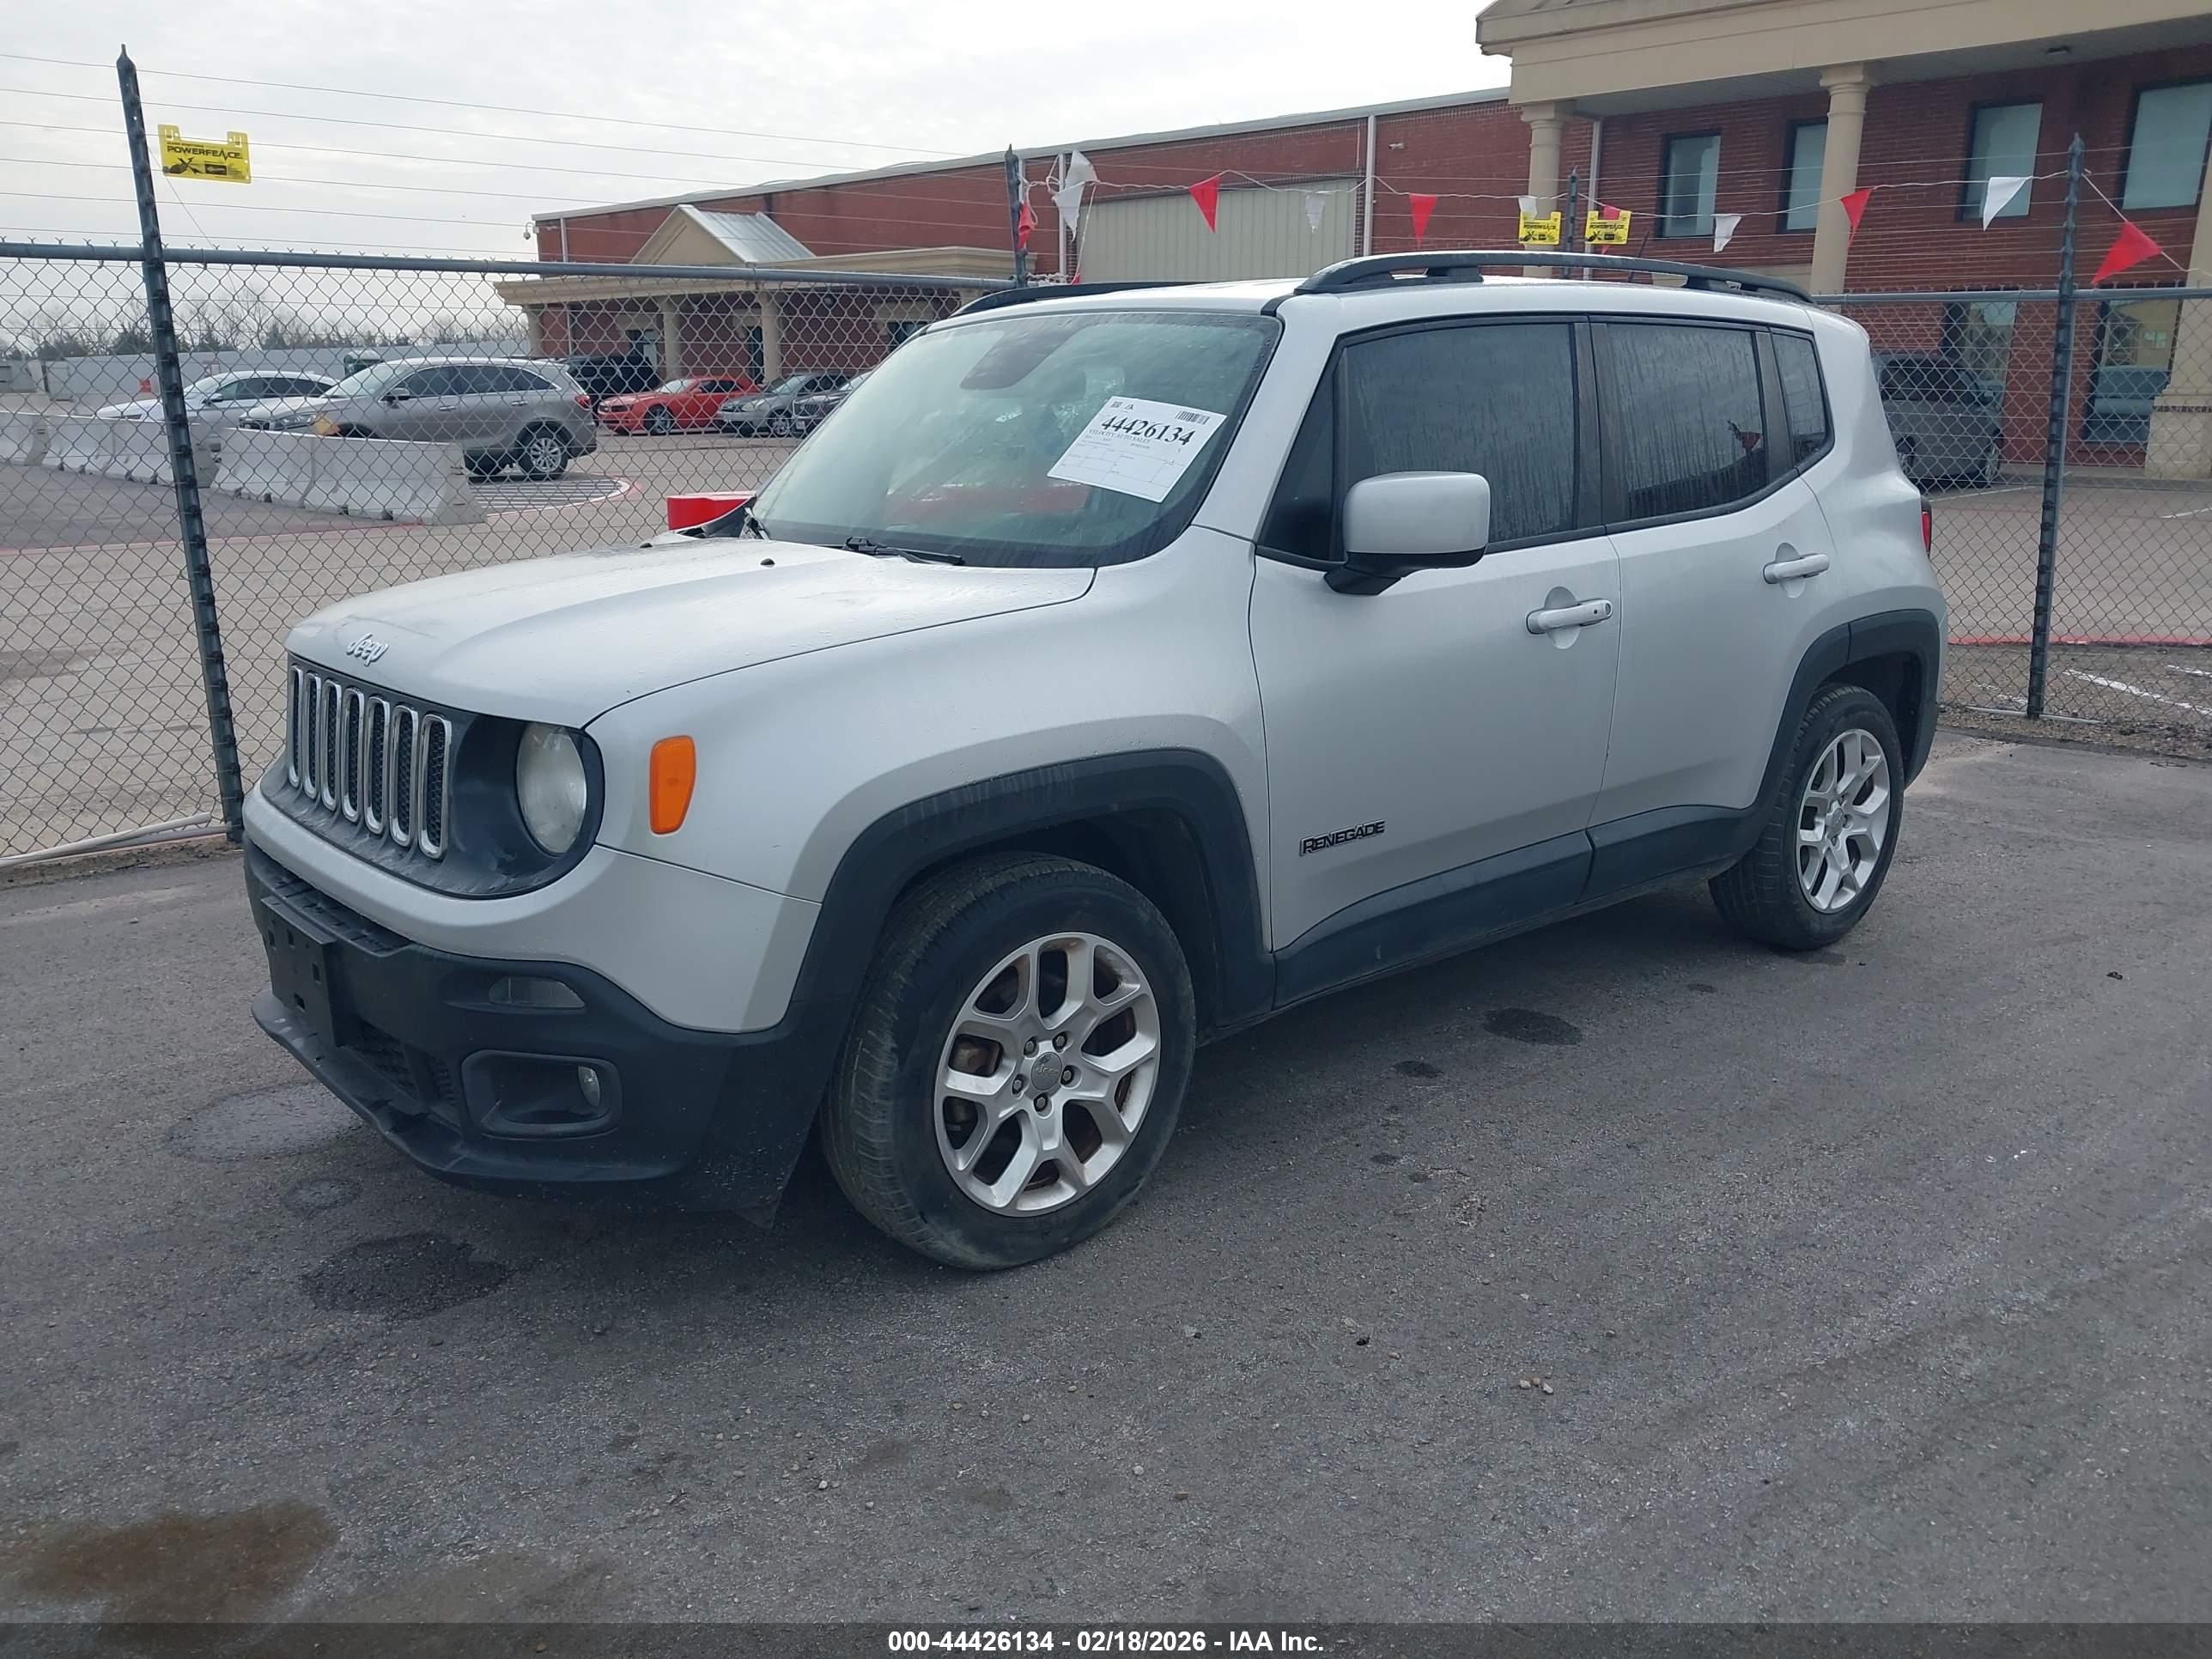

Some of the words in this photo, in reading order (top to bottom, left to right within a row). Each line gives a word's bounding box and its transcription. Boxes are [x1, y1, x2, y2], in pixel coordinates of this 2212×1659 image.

[167, 145, 241, 161] POWERFENCE
[1101, 415, 1195, 446] 44426134
[346, 632, 389, 667] Jeep
[1299, 818, 1386, 857] RENEGADE
